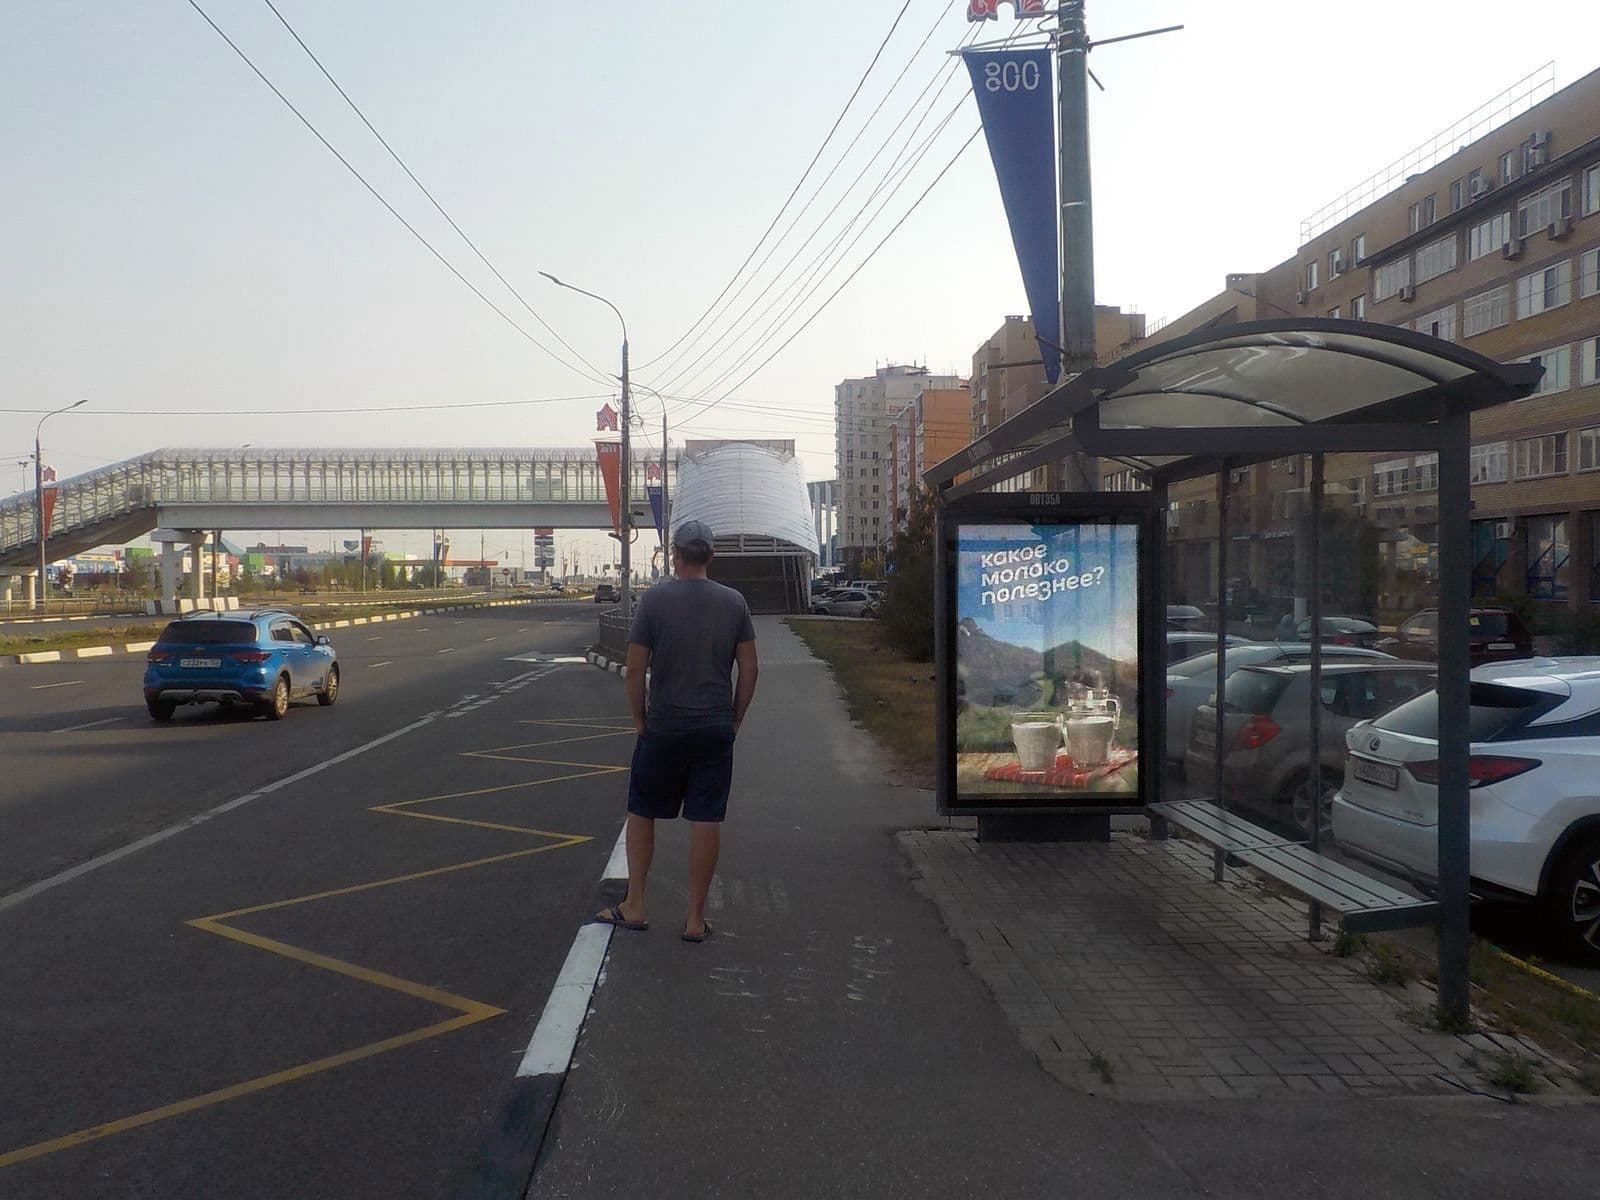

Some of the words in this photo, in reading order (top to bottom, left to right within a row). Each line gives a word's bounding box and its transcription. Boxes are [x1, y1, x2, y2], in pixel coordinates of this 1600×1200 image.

[984, 60, 1040, 92] 800
[981, 544, 1048, 568] какое
[981, 559, 1070, 587] молоко
[981, 566, 1105, 605] полезнее?
